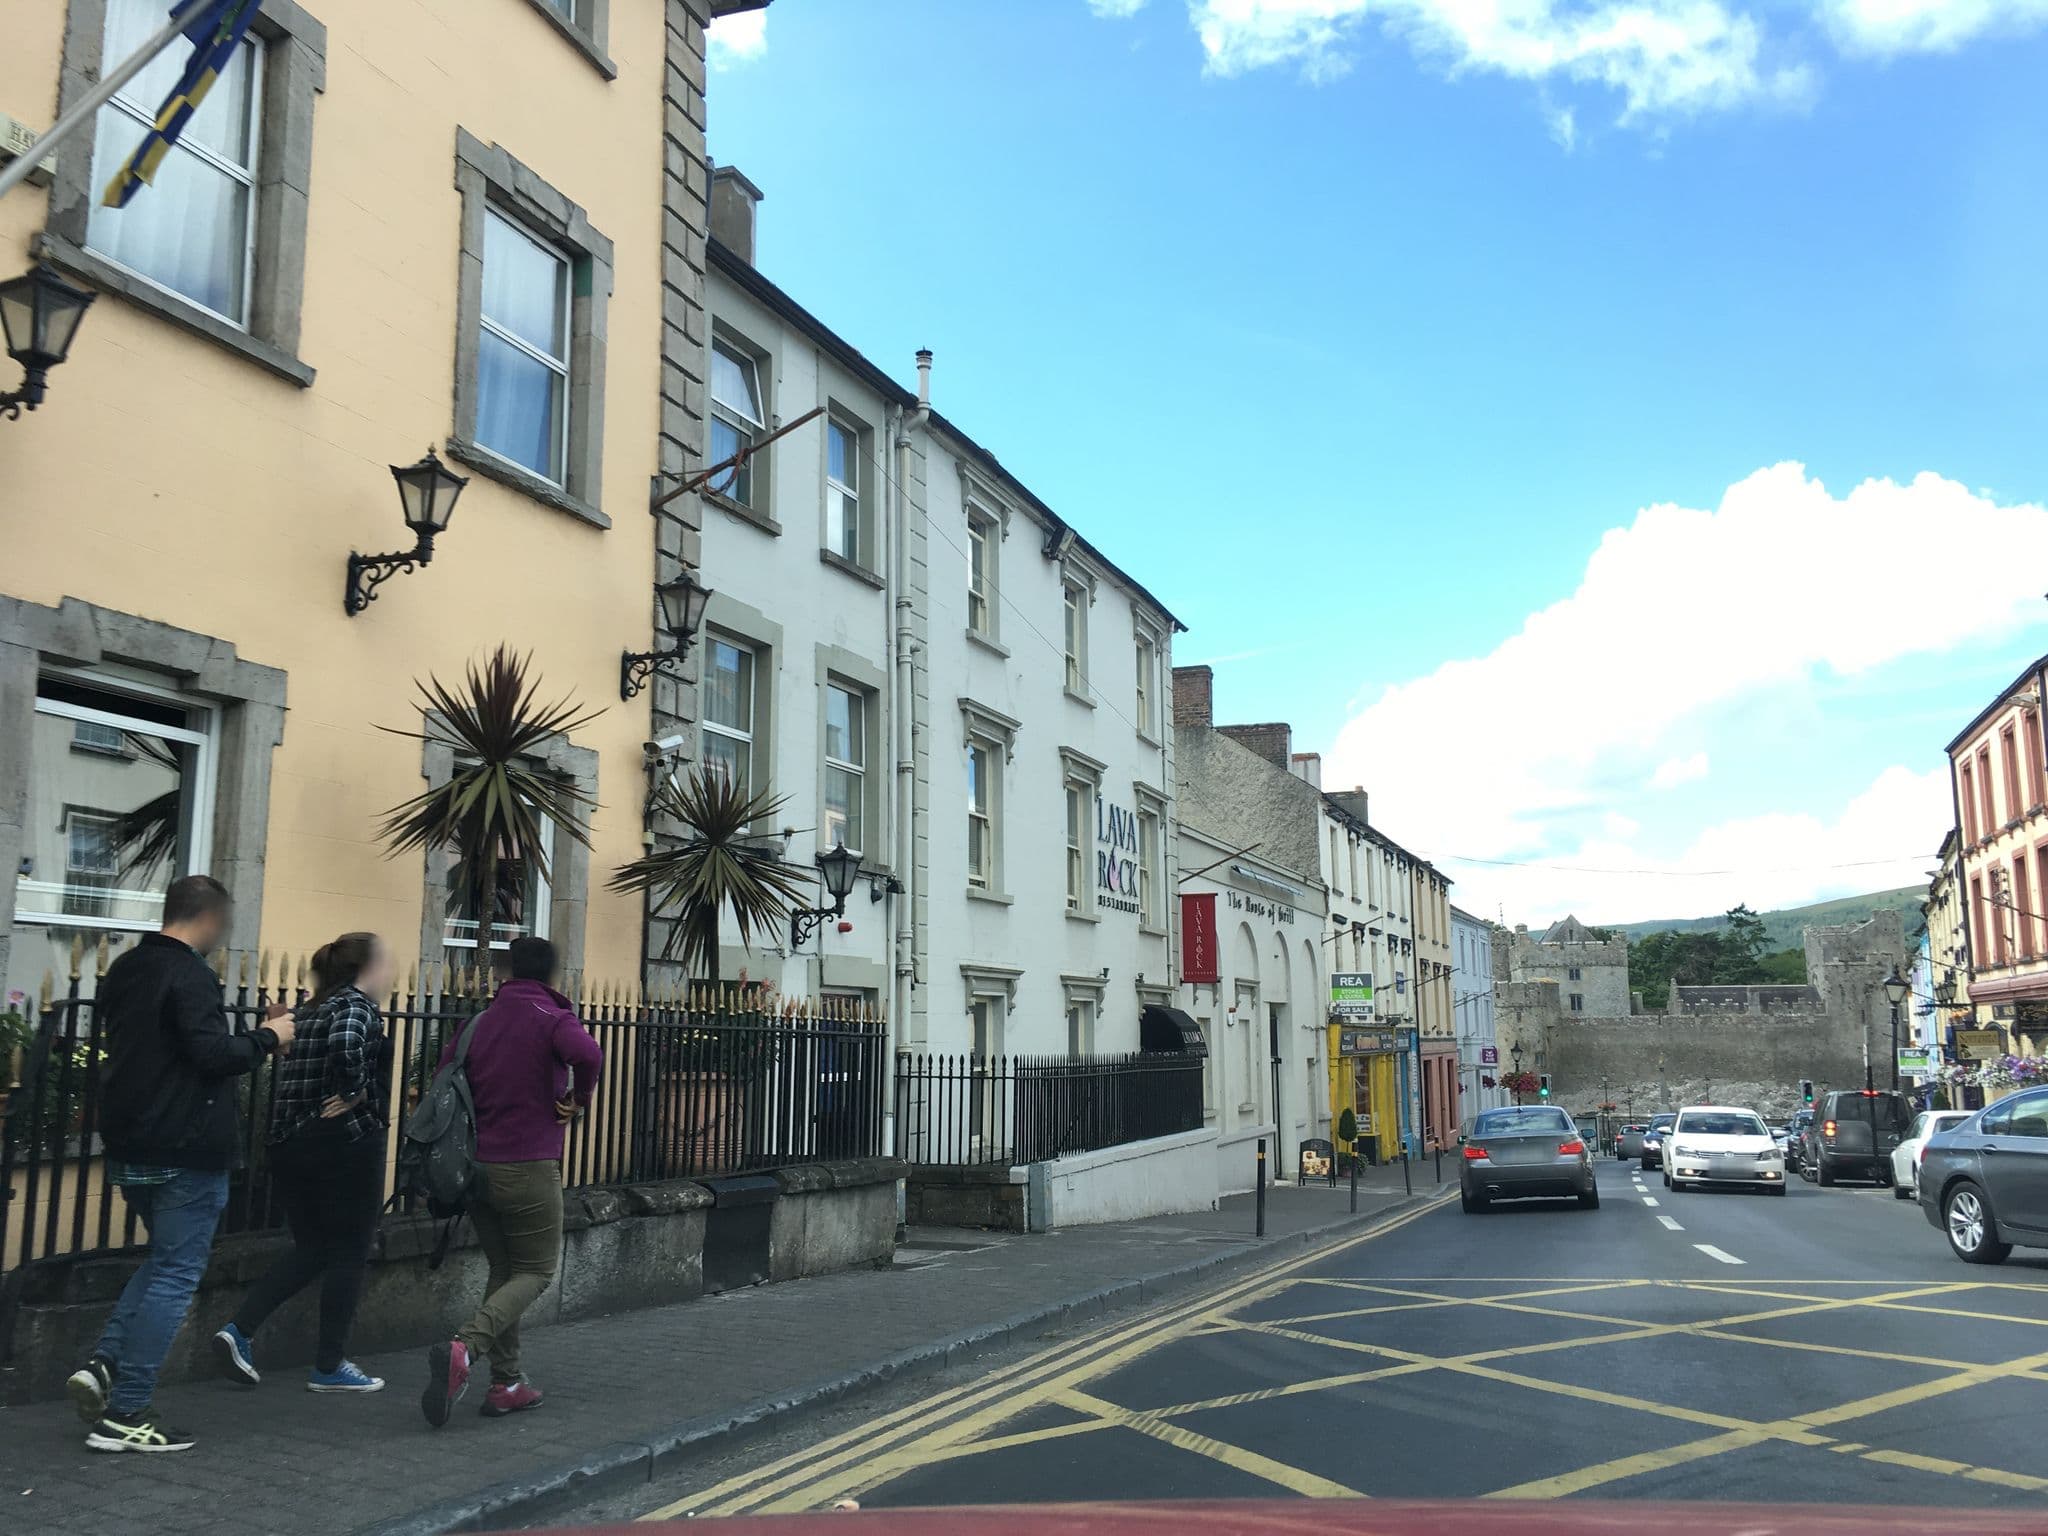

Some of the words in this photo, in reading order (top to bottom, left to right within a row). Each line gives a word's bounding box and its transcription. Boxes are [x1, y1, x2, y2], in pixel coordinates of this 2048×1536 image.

[1098, 798, 1137, 853] LAVA
[1098, 848, 1138, 898] ROCK
[1195, 902, 1203, 933] LAVA
[1227, 890, 1242, 909] The
[1246, 896, 1265, 916] House
[1268, 904, 1276, 925] of
[1340, 977, 1363, 986] REA
